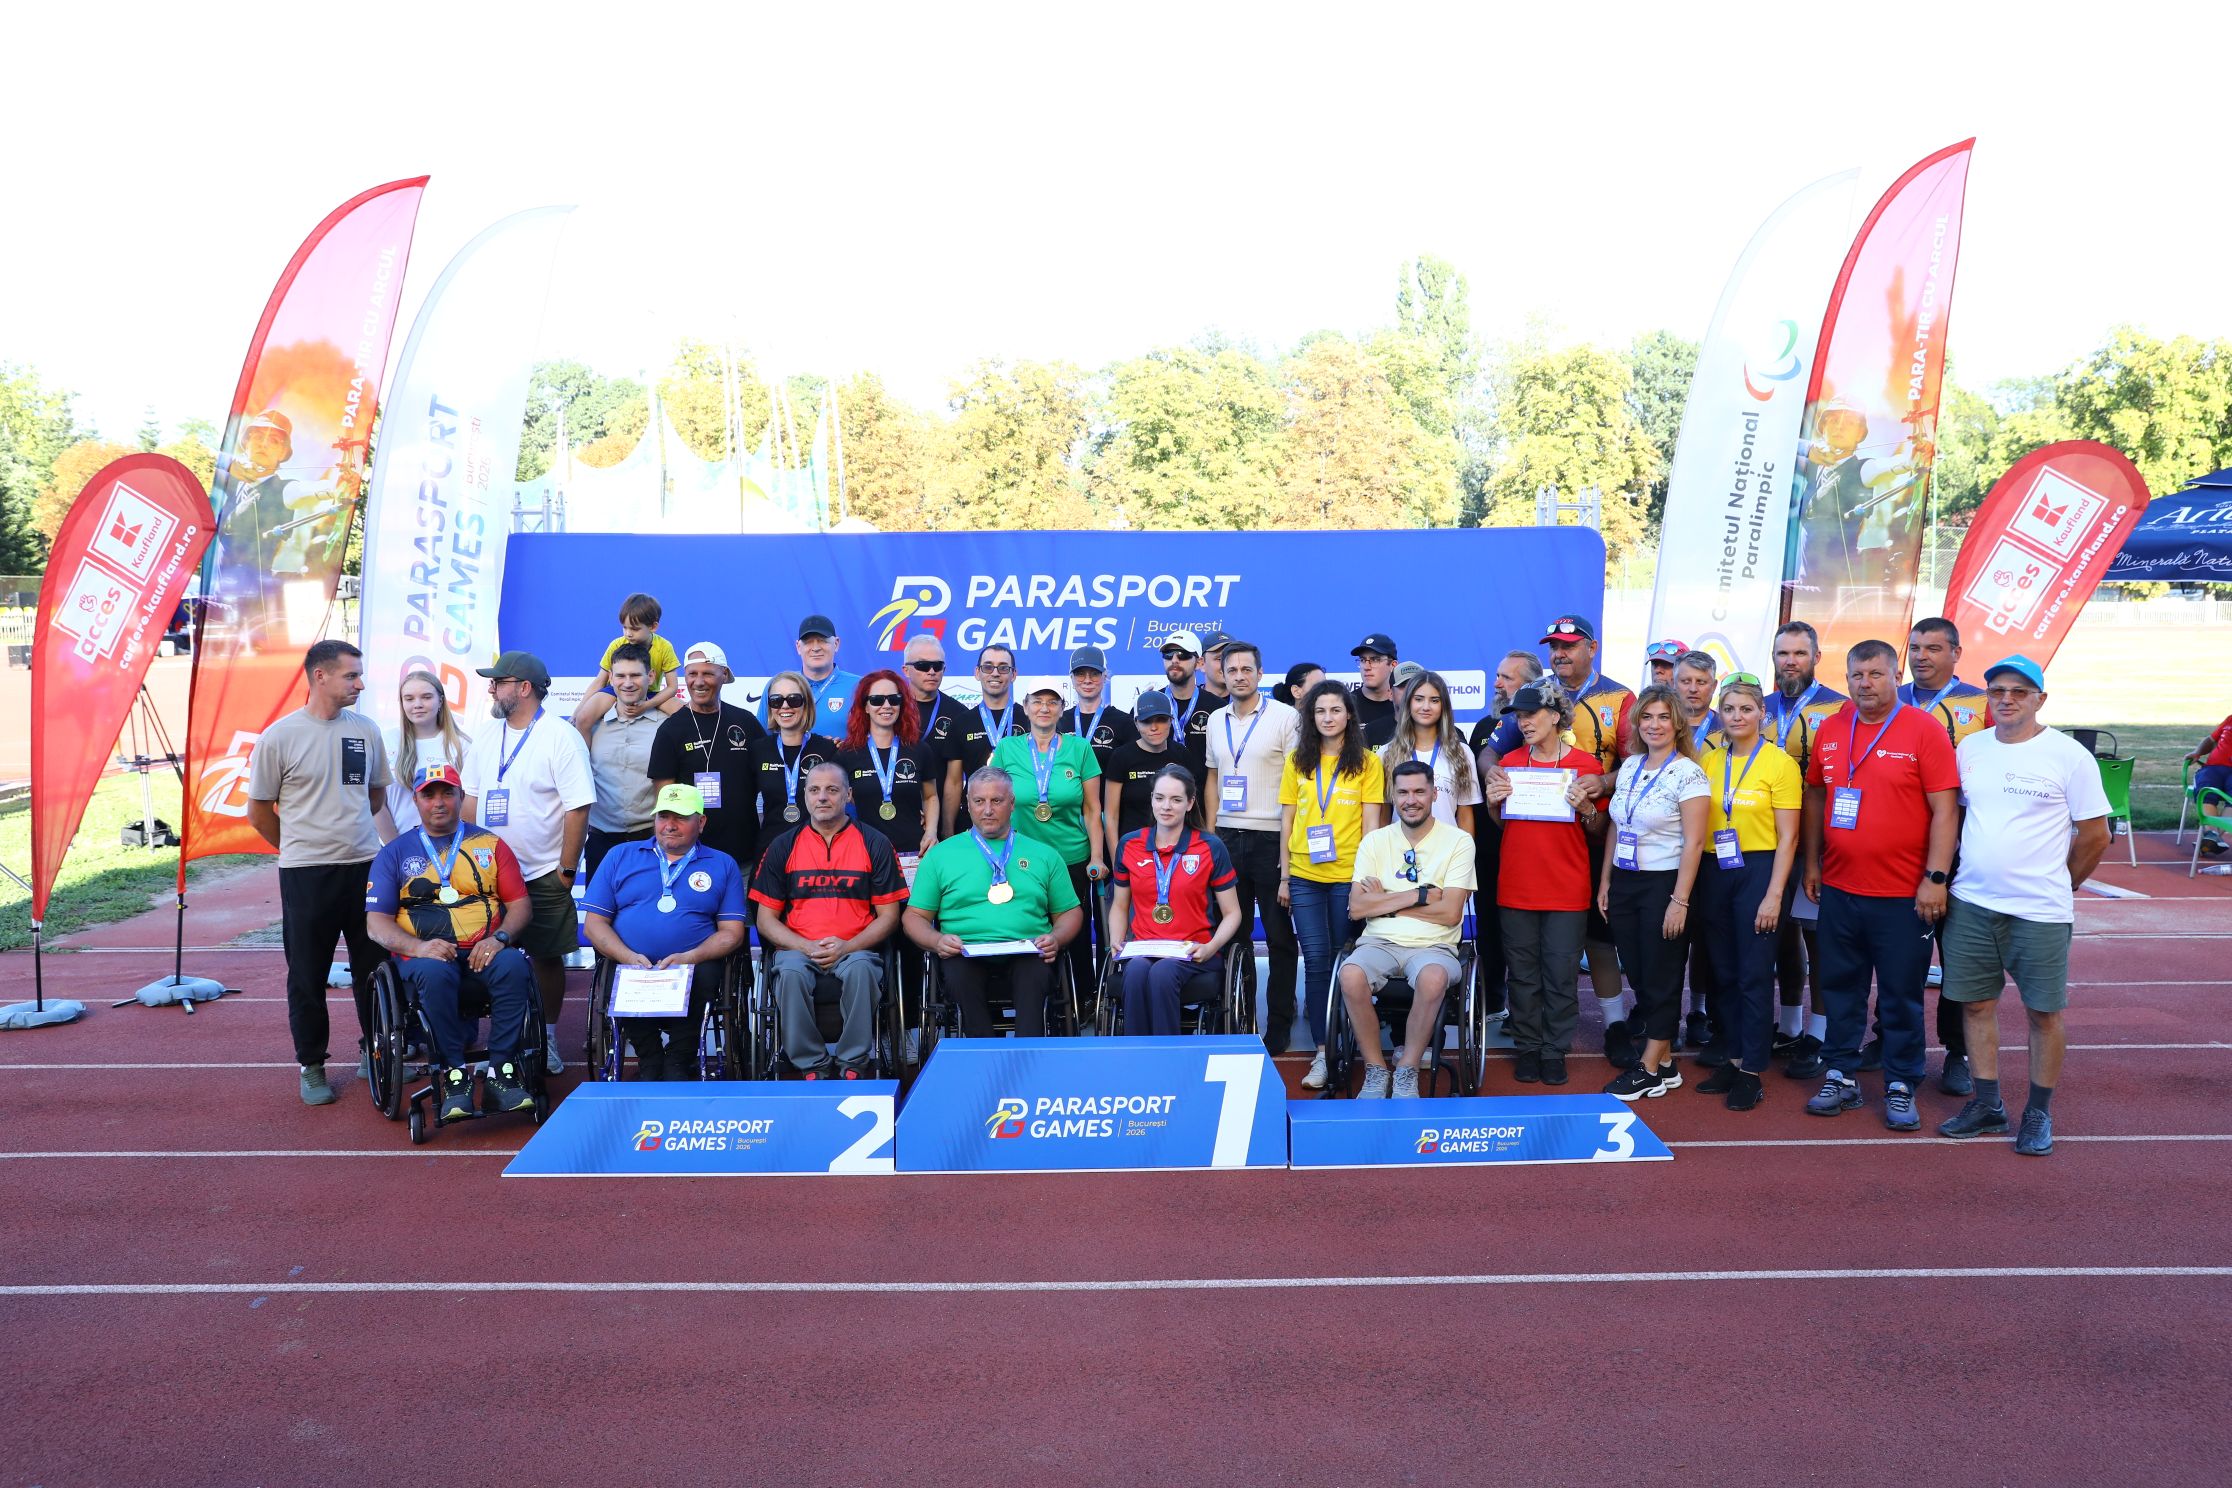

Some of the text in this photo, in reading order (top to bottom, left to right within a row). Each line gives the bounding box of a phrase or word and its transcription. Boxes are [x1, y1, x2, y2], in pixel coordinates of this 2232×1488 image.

[1908, 214, 1949, 401] PARA-TIR CU ARCUL
[342, 247, 398, 428] PARA-TIR CU ARCUL
[404, 393, 459, 642] PARASPORT
[1712, 411, 1759, 622] Cmitetul Național
[1742, 461, 1775, 579] Paralimpic
[2054, 498, 2090, 546] Kaufland
[131, 516, 163, 569] Kaufland
[2116, 551, 2191, 566] Minerală
[443, 510, 485, 655] GAMES
[2033, 505, 2127, 640] cariere.kaufland.ro
[120, 525, 197, 670] cariere.kaufland.ro
[966, 575, 1241, 608] PARASPORT
[1993, 563, 2040, 628] acces
[81, 587, 121, 656] acces
[957, 617, 1117, 651] GAMES
[1147, 619, 1223, 634] București
[1447, 685, 1480, 694] THLON
[1337, 798, 1357, 806] STAFF
[1732, 798, 1757, 807] STAFF
[2003, 786, 2050, 799] VOLUNTAR
[797, 875, 860, 888] HOYT
[1035, 1095, 1176, 1116] PARASPORT
[1204, 1054, 1265, 1167] 1
[669, 1119, 774, 1134] PARASPORT
[829, 1095, 894, 1172] 2
[1030, 1119, 1113, 1138] GAMES
[1126, 1128, 1146, 1136] 2026
[1128, 1119, 1167, 1128] București
[1443, 1126, 1524, 1140] PARASPORT
[1592, 1112, 1637, 1159] 3
[664, 1136, 727, 1151] GAMES
[1440, 1141, 1489, 1153] GAMES
